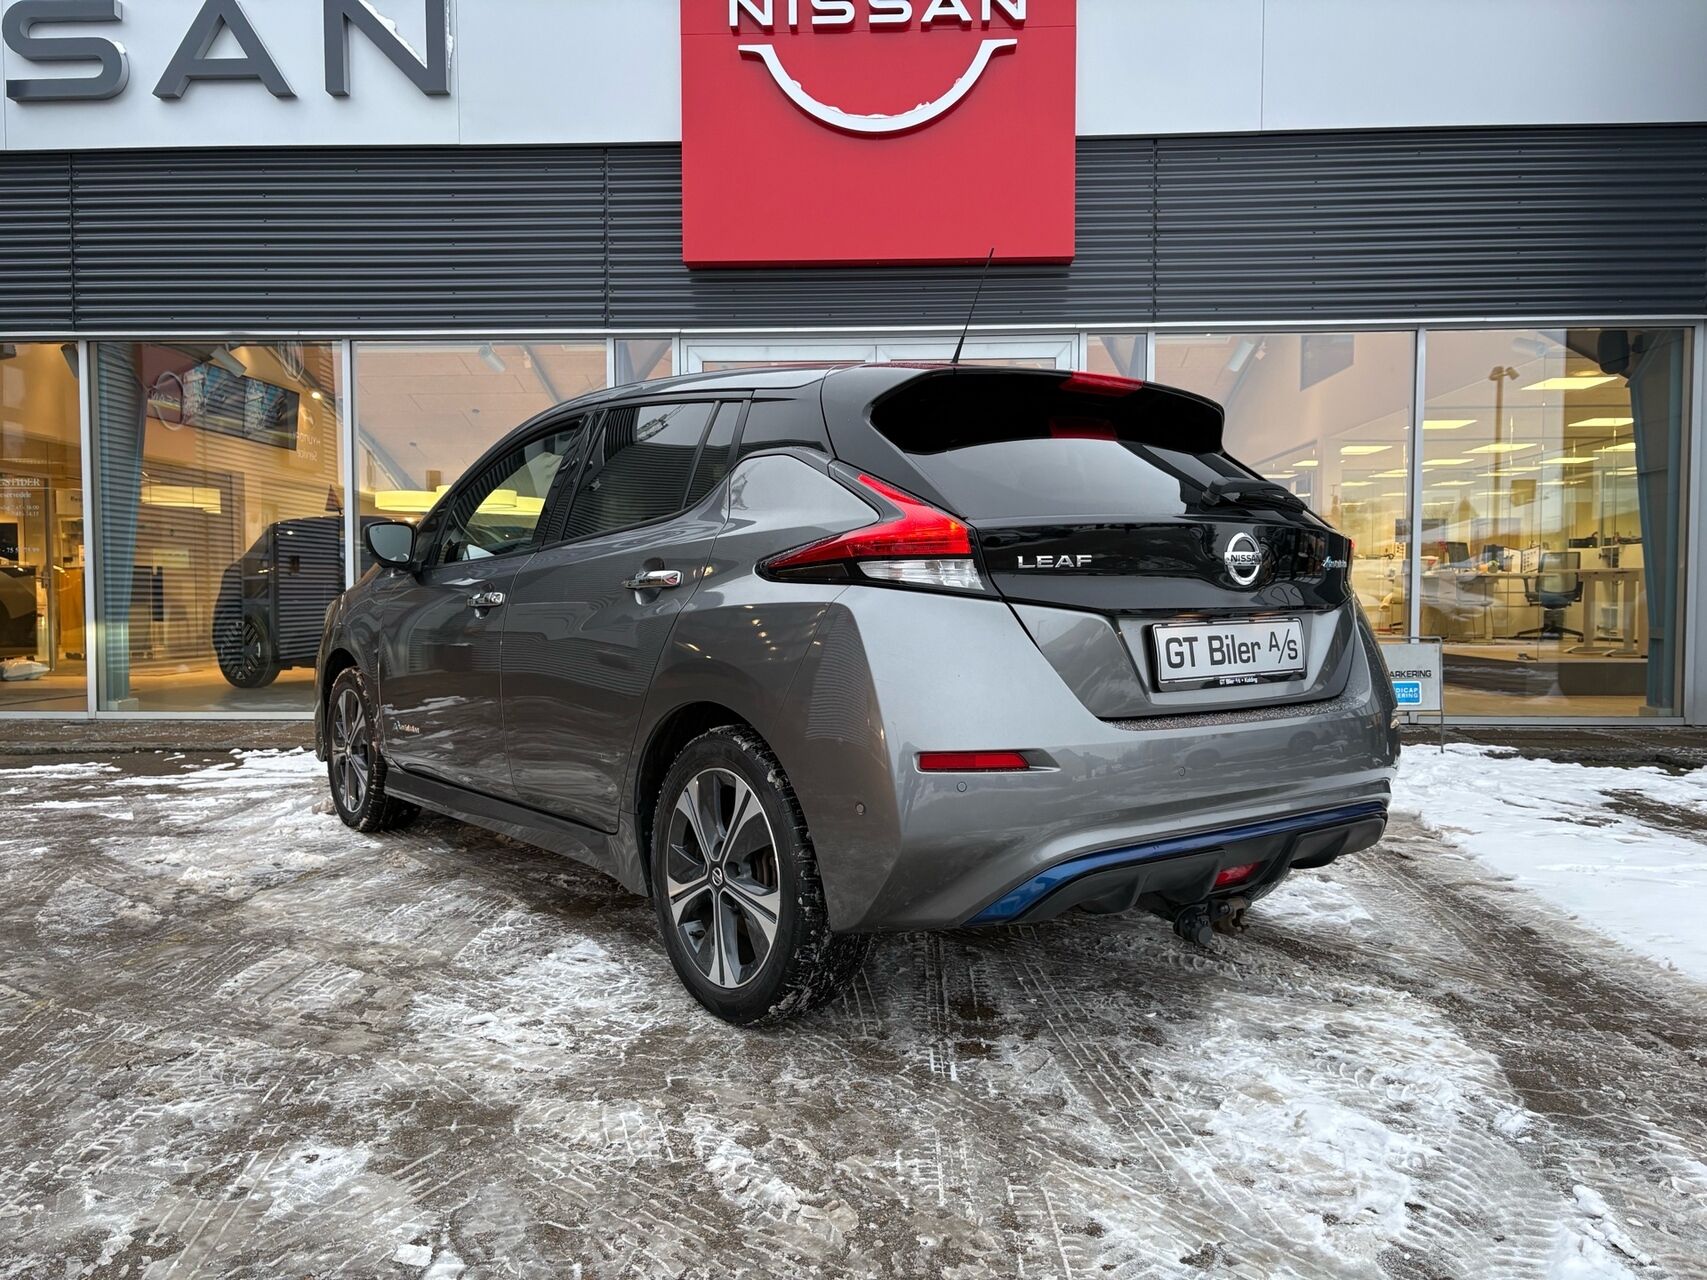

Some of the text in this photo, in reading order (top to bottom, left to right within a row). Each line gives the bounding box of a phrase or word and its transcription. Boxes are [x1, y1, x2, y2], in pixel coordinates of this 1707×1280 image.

[729, 0, 1027, 30] NISSAN
[2, 0, 451, 101] SAN
[1017, 554, 1093, 569] LEAF
[1230, 553, 1261, 563] NISSAN
[1165, 636, 1199, 669] GT
[1207, 634, 1262, 666] Biler
